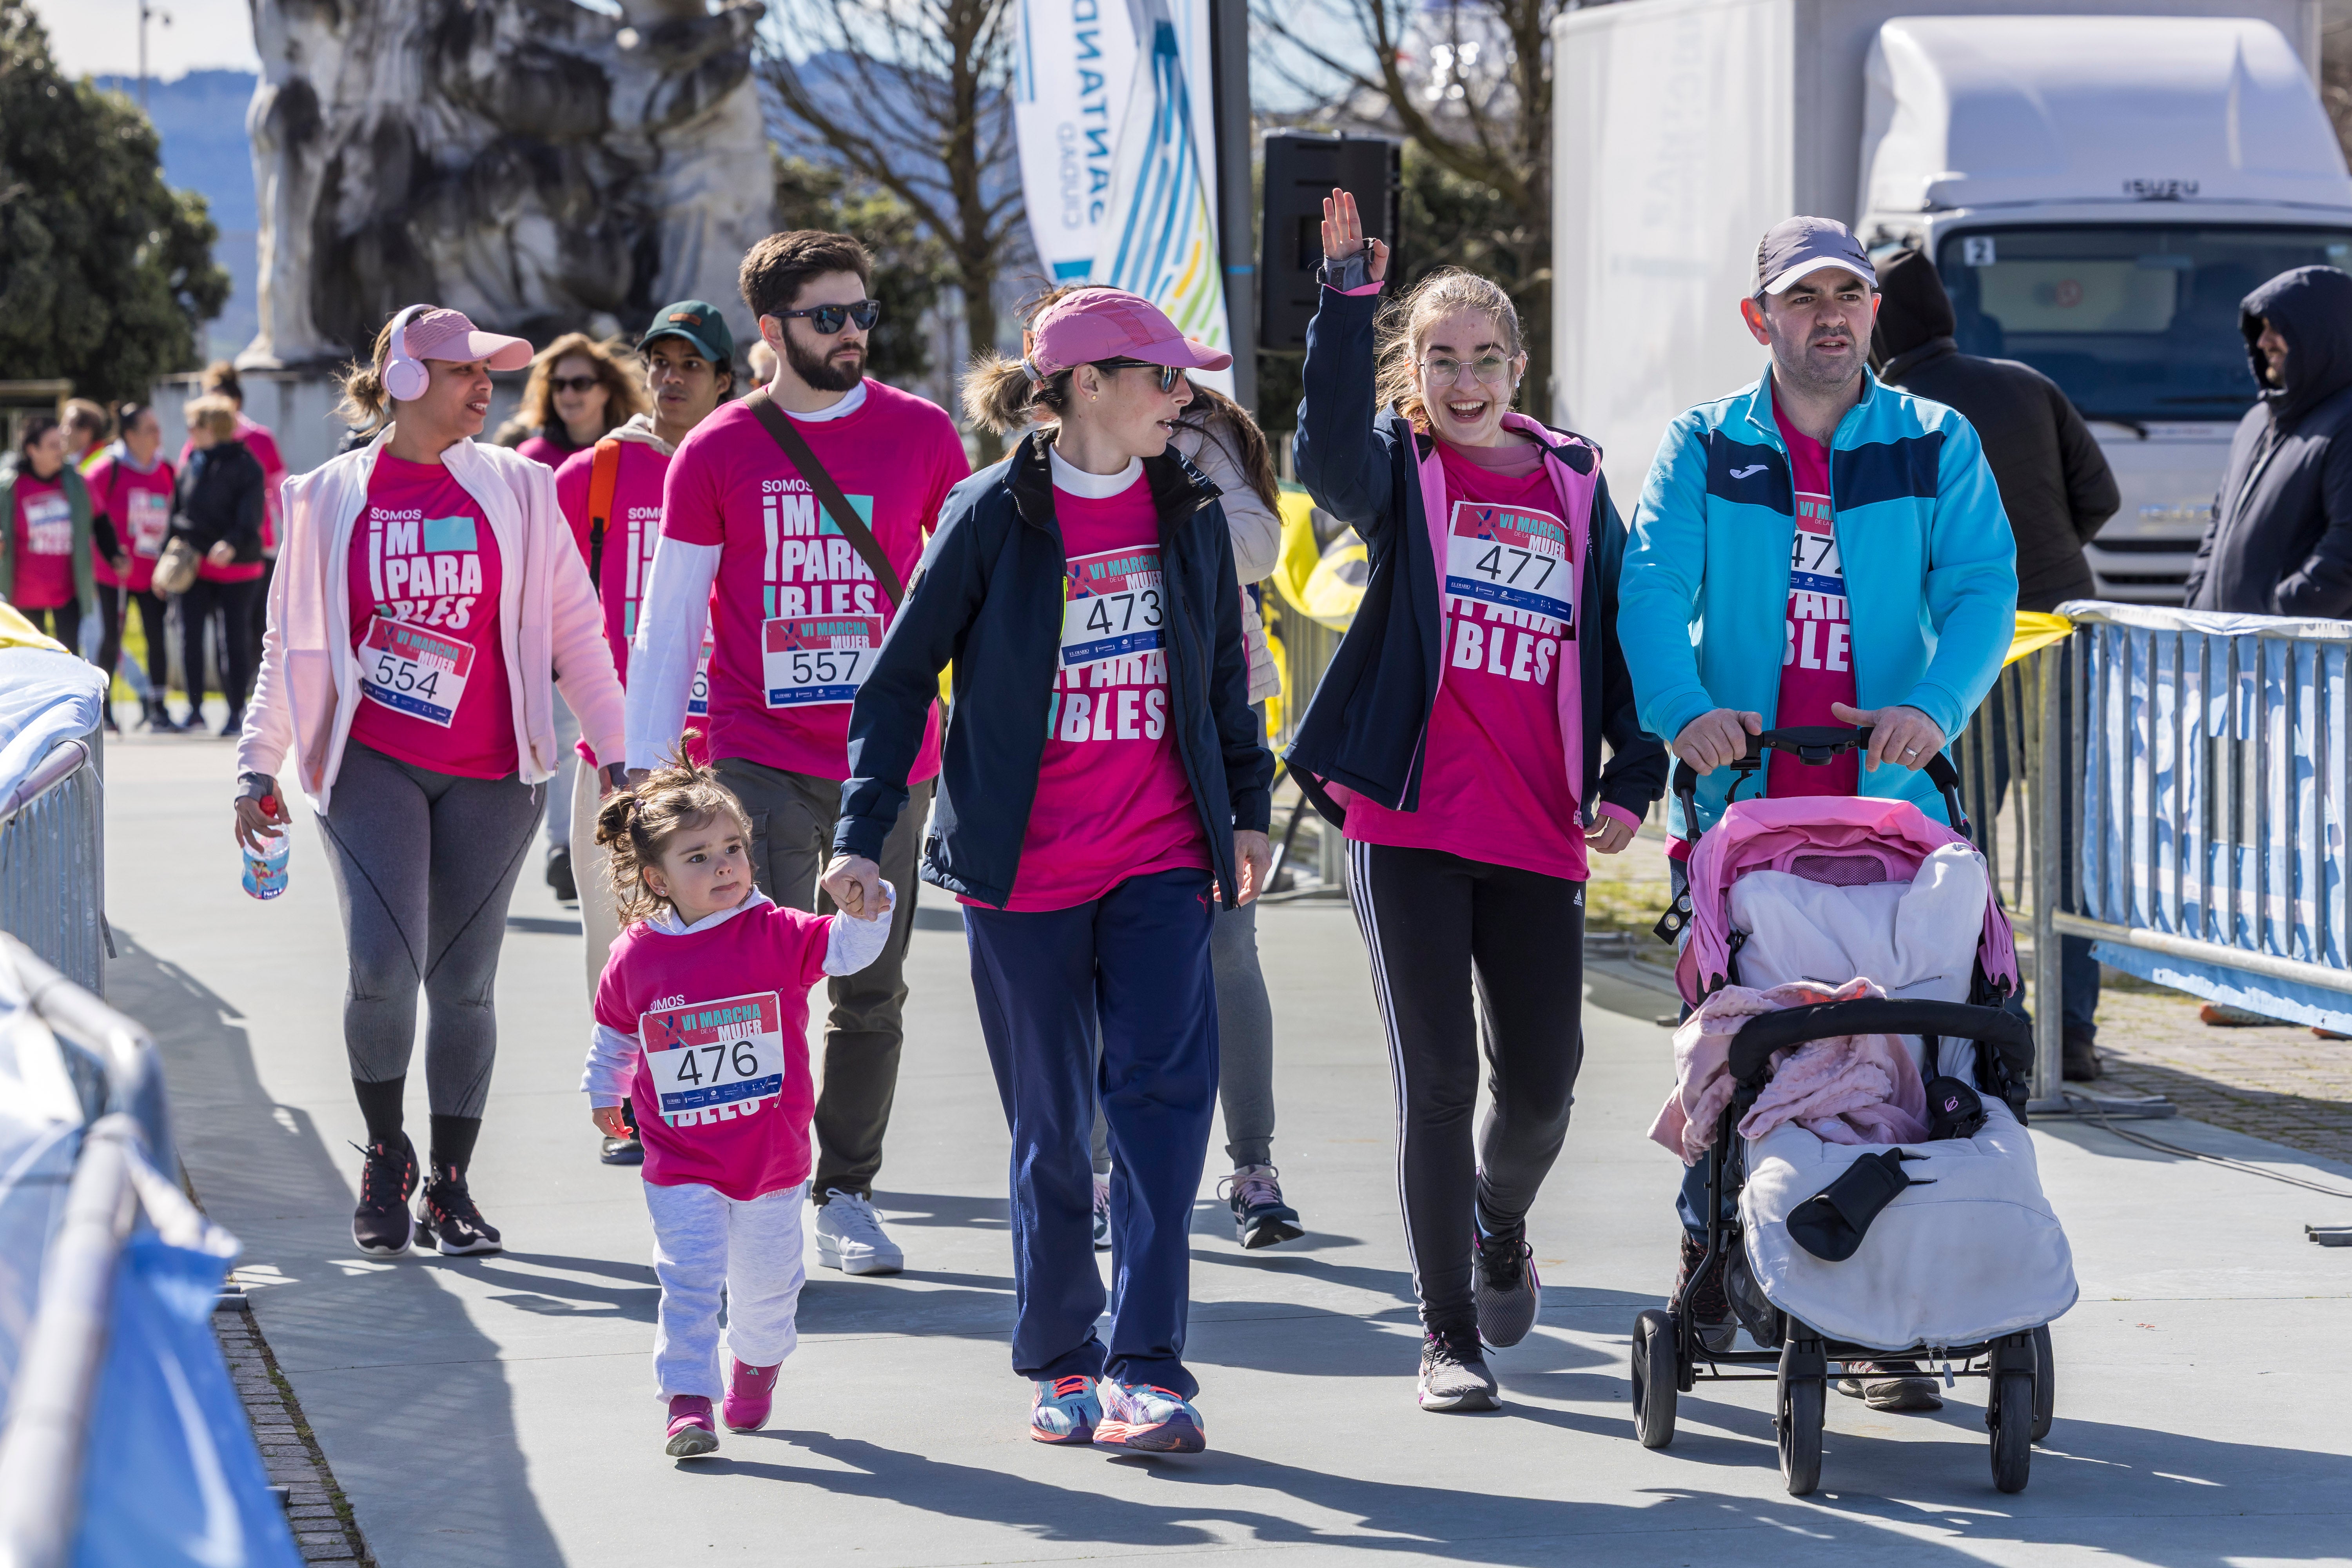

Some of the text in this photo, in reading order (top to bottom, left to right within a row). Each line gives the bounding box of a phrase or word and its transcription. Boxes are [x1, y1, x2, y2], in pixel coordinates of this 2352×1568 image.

[2122, 178, 2201, 195] ISUZU
[370, 507, 422, 521] SOMOS
[628, 507, 663, 520] SOM
[1799, 501, 1815, 517] VI
[1499, 513, 1515, 530] VI
[1516, 516, 1566, 545] MARCHA
[782, 538, 875, 582] PARA
[1528, 534, 1566, 560] MUJER
[1791, 533, 1843, 575] 47
[385, 554, 483, 599] PARA
[1088, 555, 1161, 580] VI MARCHA
[1125, 571, 1163, 590] MUJER
[1475, 545, 1557, 590] 477
[1086, 590, 1163, 634] 473
[800, 621, 869, 637] VI MARCHA
[830, 635, 870, 649] MUJER
[396, 630, 459, 662] VI MARCHA
[1452, 620, 1557, 685] BLES
[417, 650, 456, 674] MUJER
[792, 651, 860, 684] 557
[376, 655, 439, 699] 554
[1060, 689, 1165, 742] BLES
[681, 1004, 762, 1031] VI MARCHA
[717, 1019, 762, 1042] MUJER
[677, 1040, 758, 1086] 476
